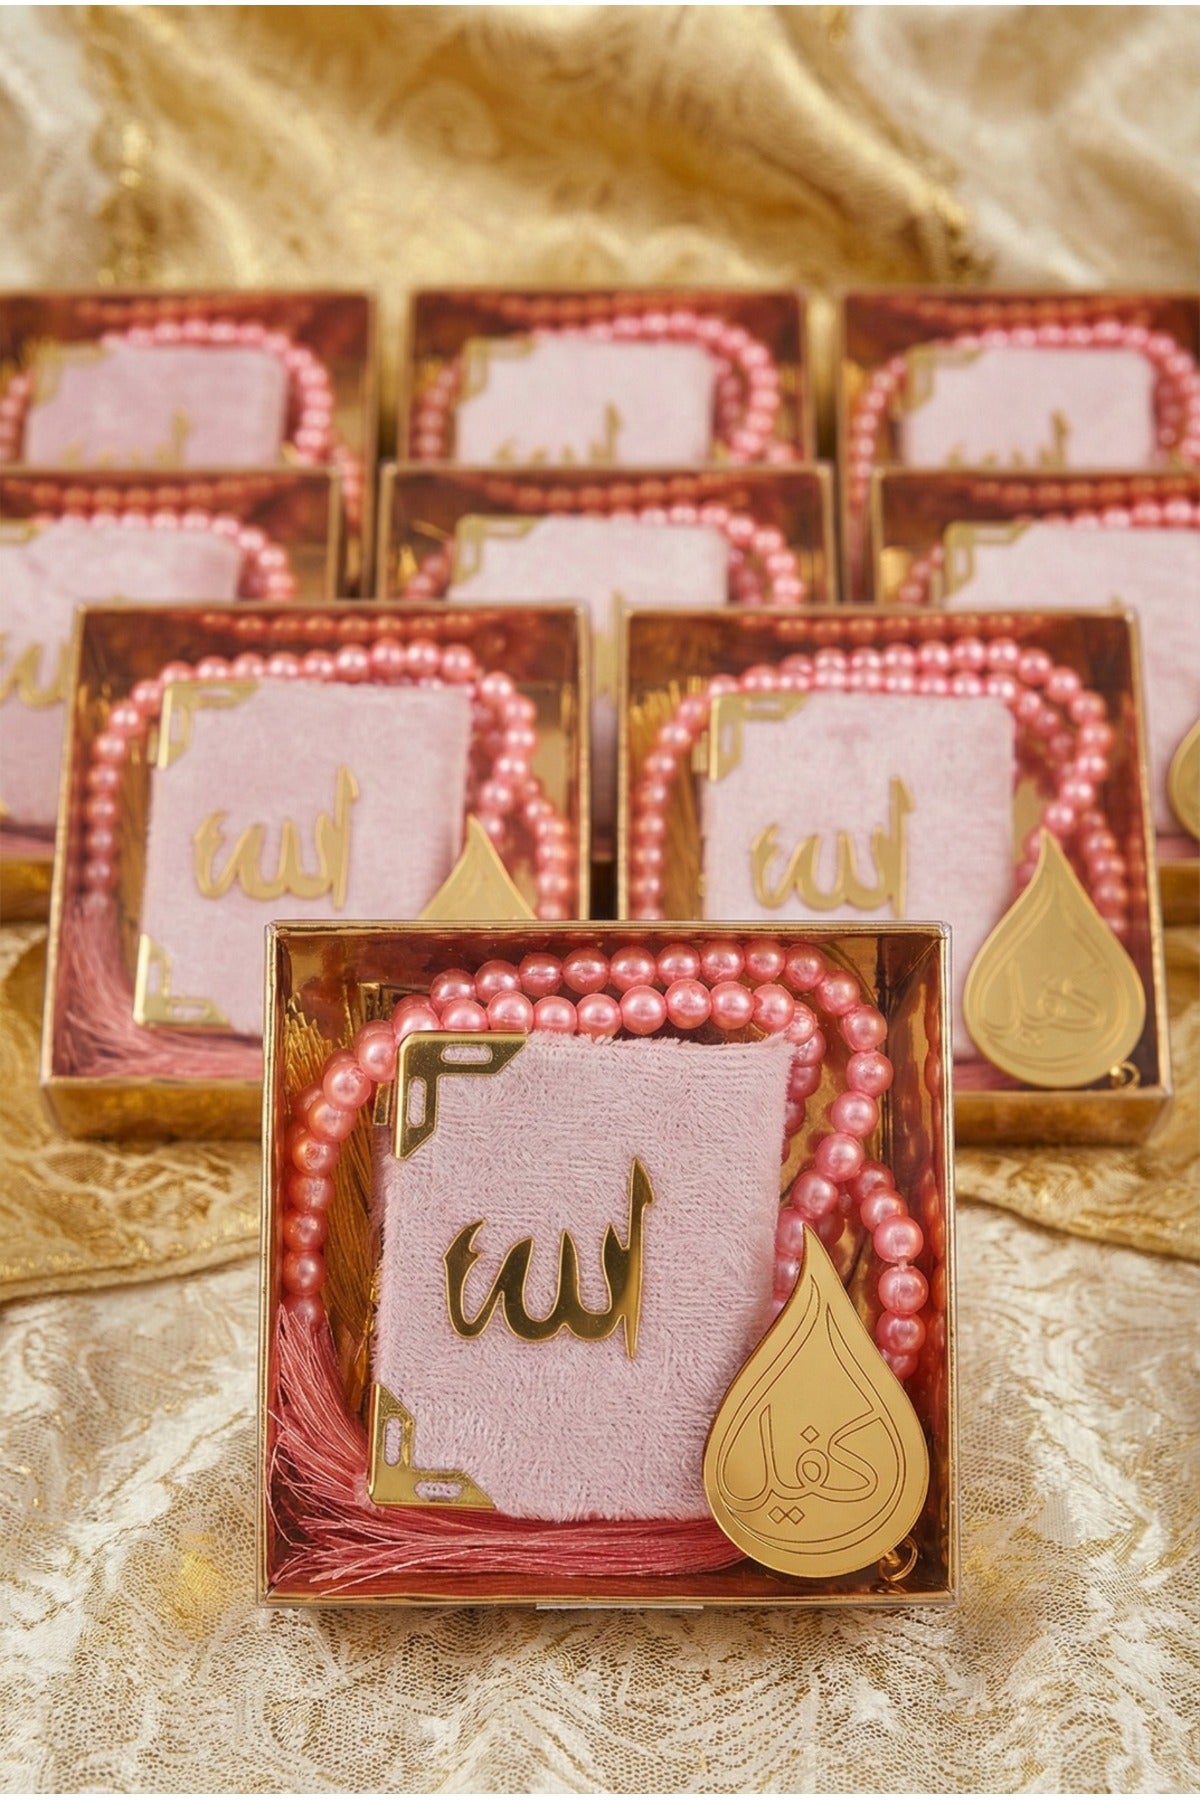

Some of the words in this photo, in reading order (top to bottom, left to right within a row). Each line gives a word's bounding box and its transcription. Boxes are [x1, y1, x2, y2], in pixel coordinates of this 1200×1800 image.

[194, 766, 359, 908] الله
[751, 775, 915, 918] الله
[442, 1156, 655, 1361] الله
